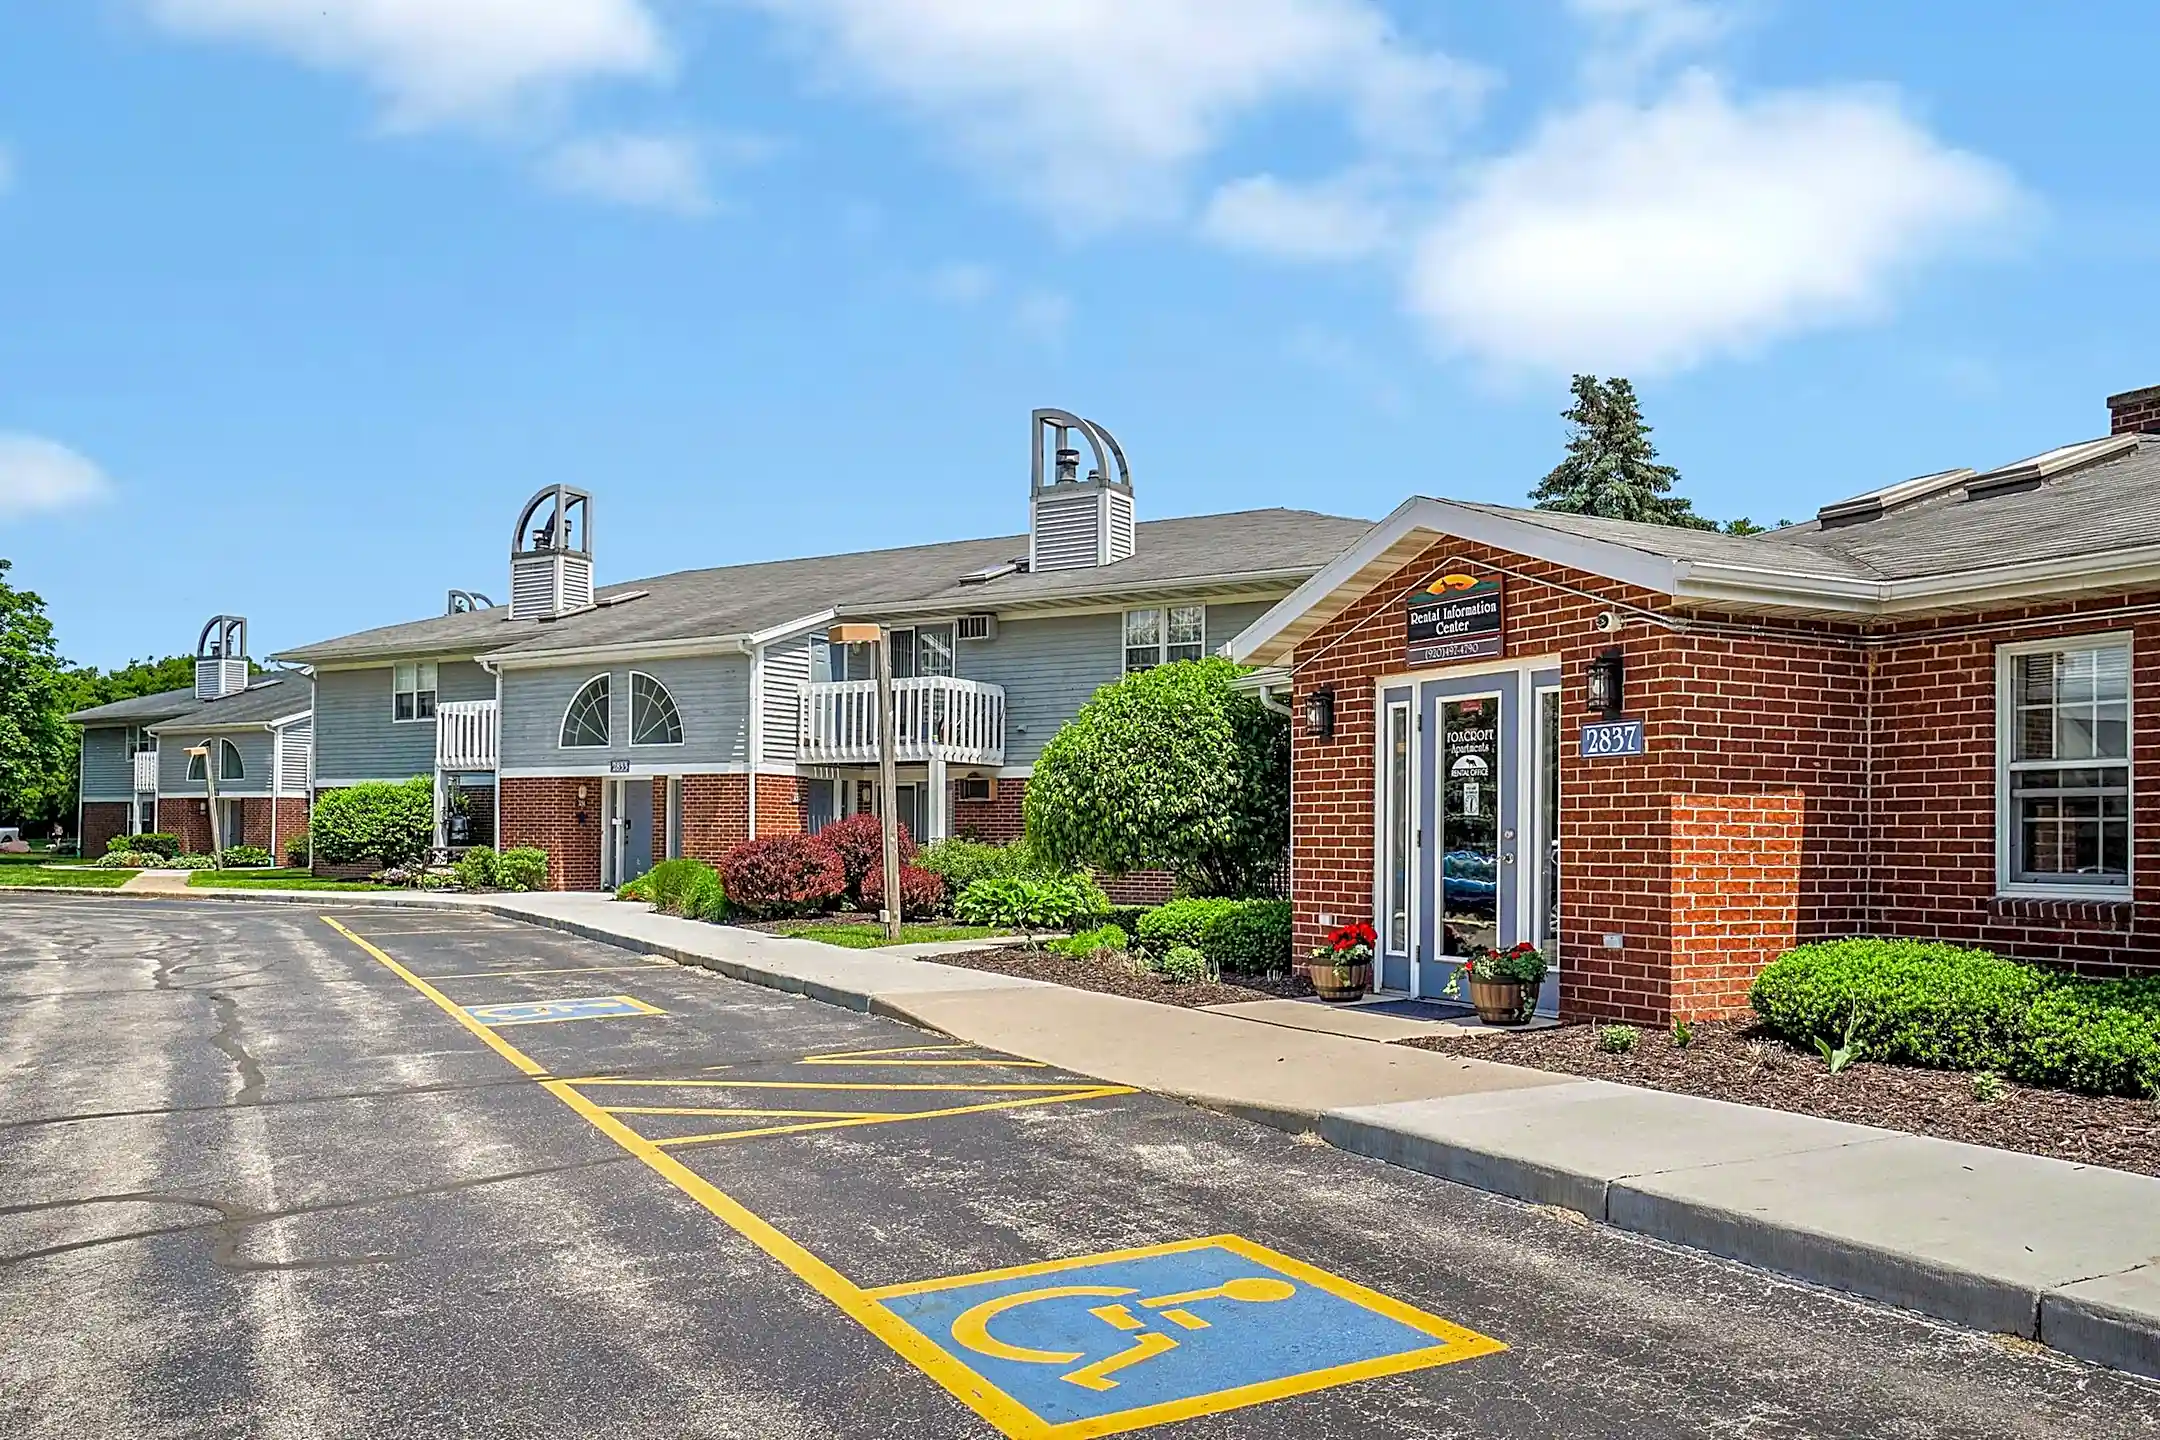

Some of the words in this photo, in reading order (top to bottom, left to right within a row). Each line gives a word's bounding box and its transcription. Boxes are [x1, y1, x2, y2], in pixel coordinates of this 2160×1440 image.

[1410, 608, 1440, 625] Rental
[1443, 600, 1497, 619] Information
[1435, 620, 1470, 635] Center
[1447, 729, 1494, 743] FOXCROFT
[1586, 725, 1637, 753] 2837
[1451, 742, 1489, 757] Apartments
[1451, 769, 1470, 777] RENTAL
[1470, 768, 1489, 777] OFFICE
